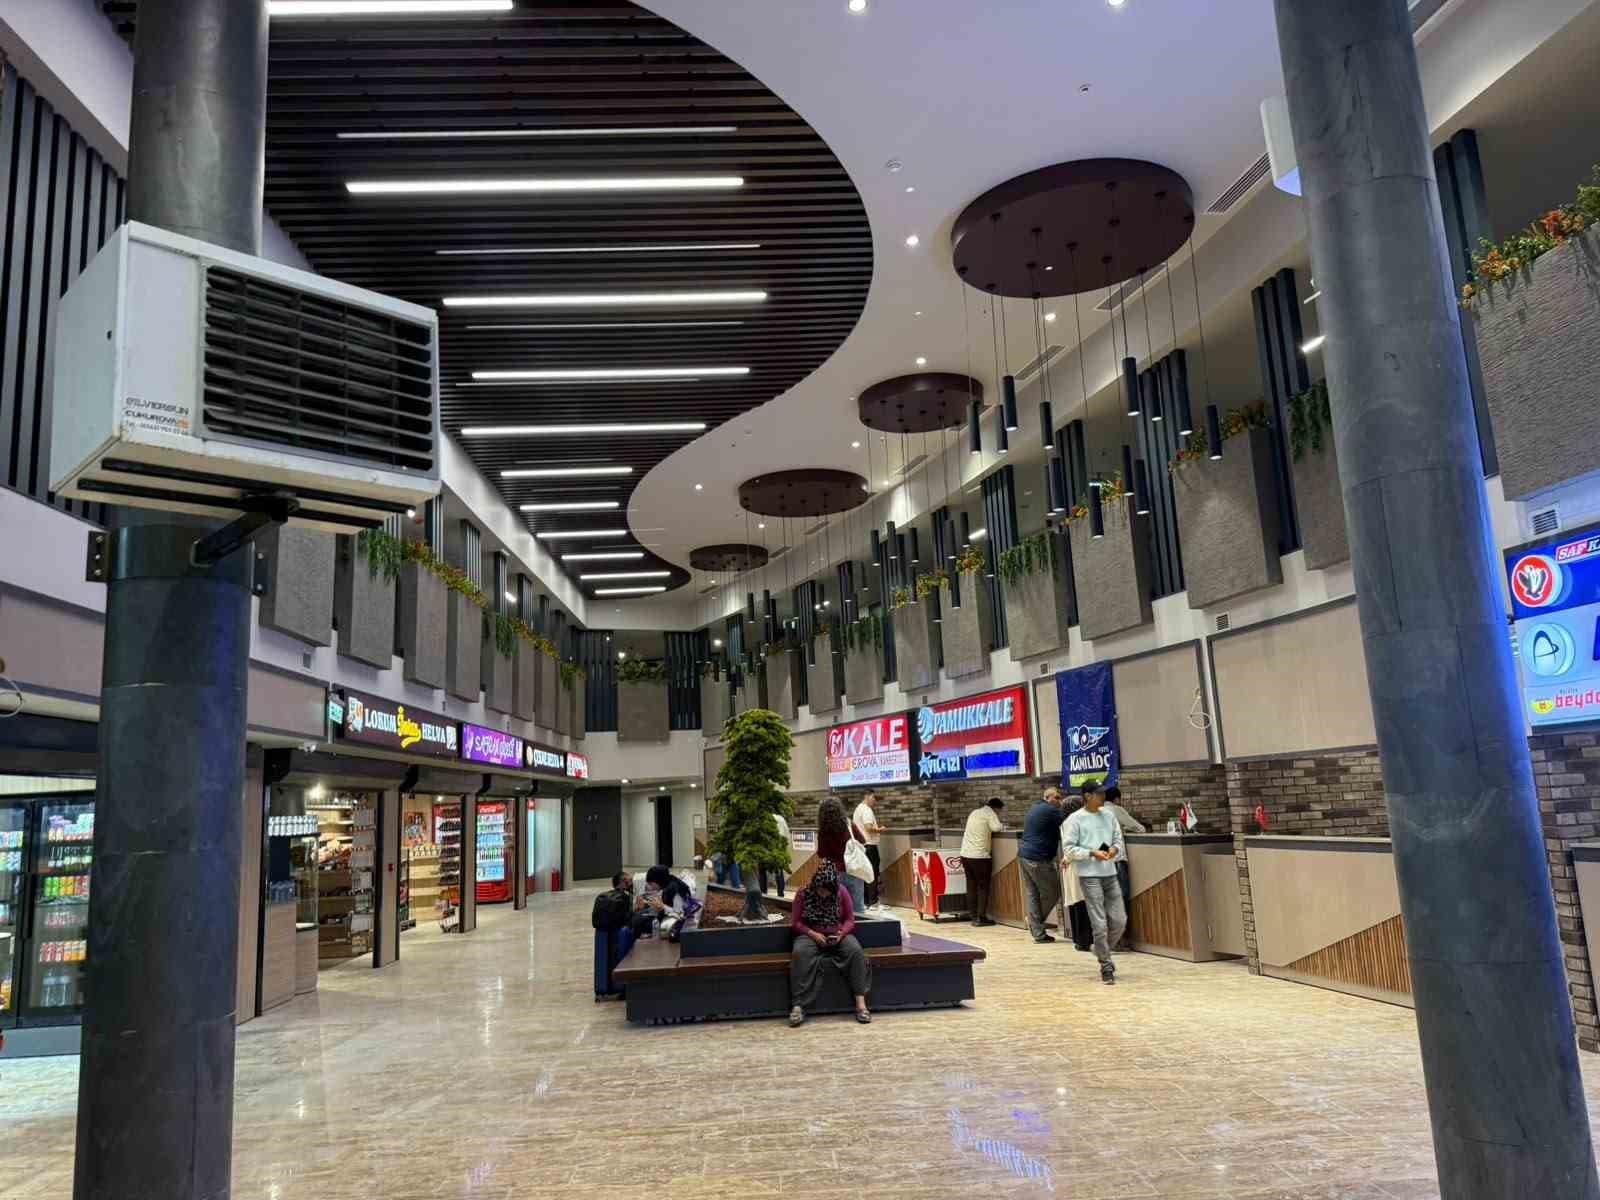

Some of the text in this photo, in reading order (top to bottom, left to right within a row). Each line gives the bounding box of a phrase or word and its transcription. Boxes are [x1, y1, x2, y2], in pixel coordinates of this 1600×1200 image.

[364, 708, 397, 733] LOKUM
[422, 723, 446, 744] HELVA
[933, 697, 1013, 735] PAMUKKALE
[843, 718, 904, 757] KALE
